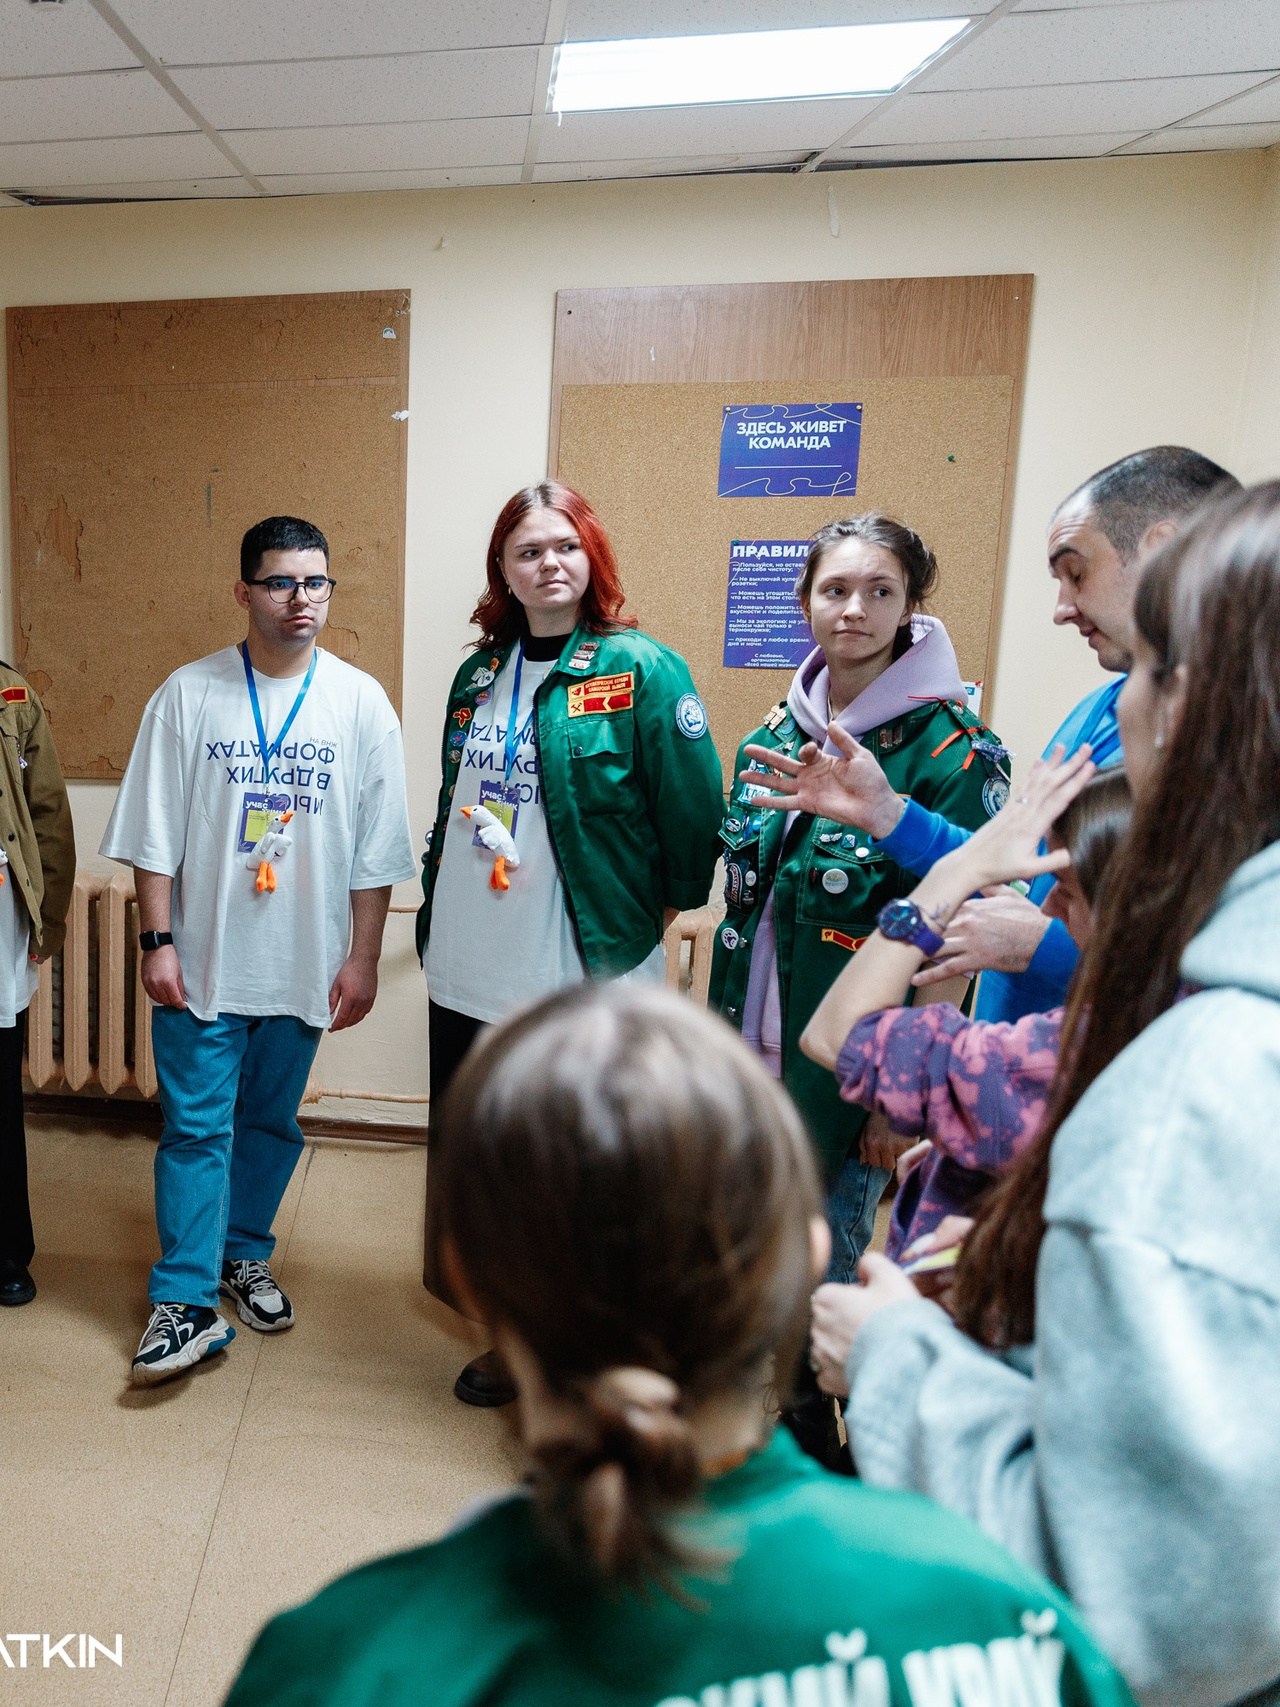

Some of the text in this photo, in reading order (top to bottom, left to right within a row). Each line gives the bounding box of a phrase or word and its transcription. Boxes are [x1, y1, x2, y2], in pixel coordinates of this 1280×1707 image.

[736, 420, 847, 436] ЗДЕСЬ ЖИВЕТ
[748, 436, 831, 450] КОМАНДА
[732, 545, 810, 558] ПРАВИЛ
[205, 740, 335, 764] ФОРМАТАХ
[226, 765, 315, 787] ДРУГИХ
